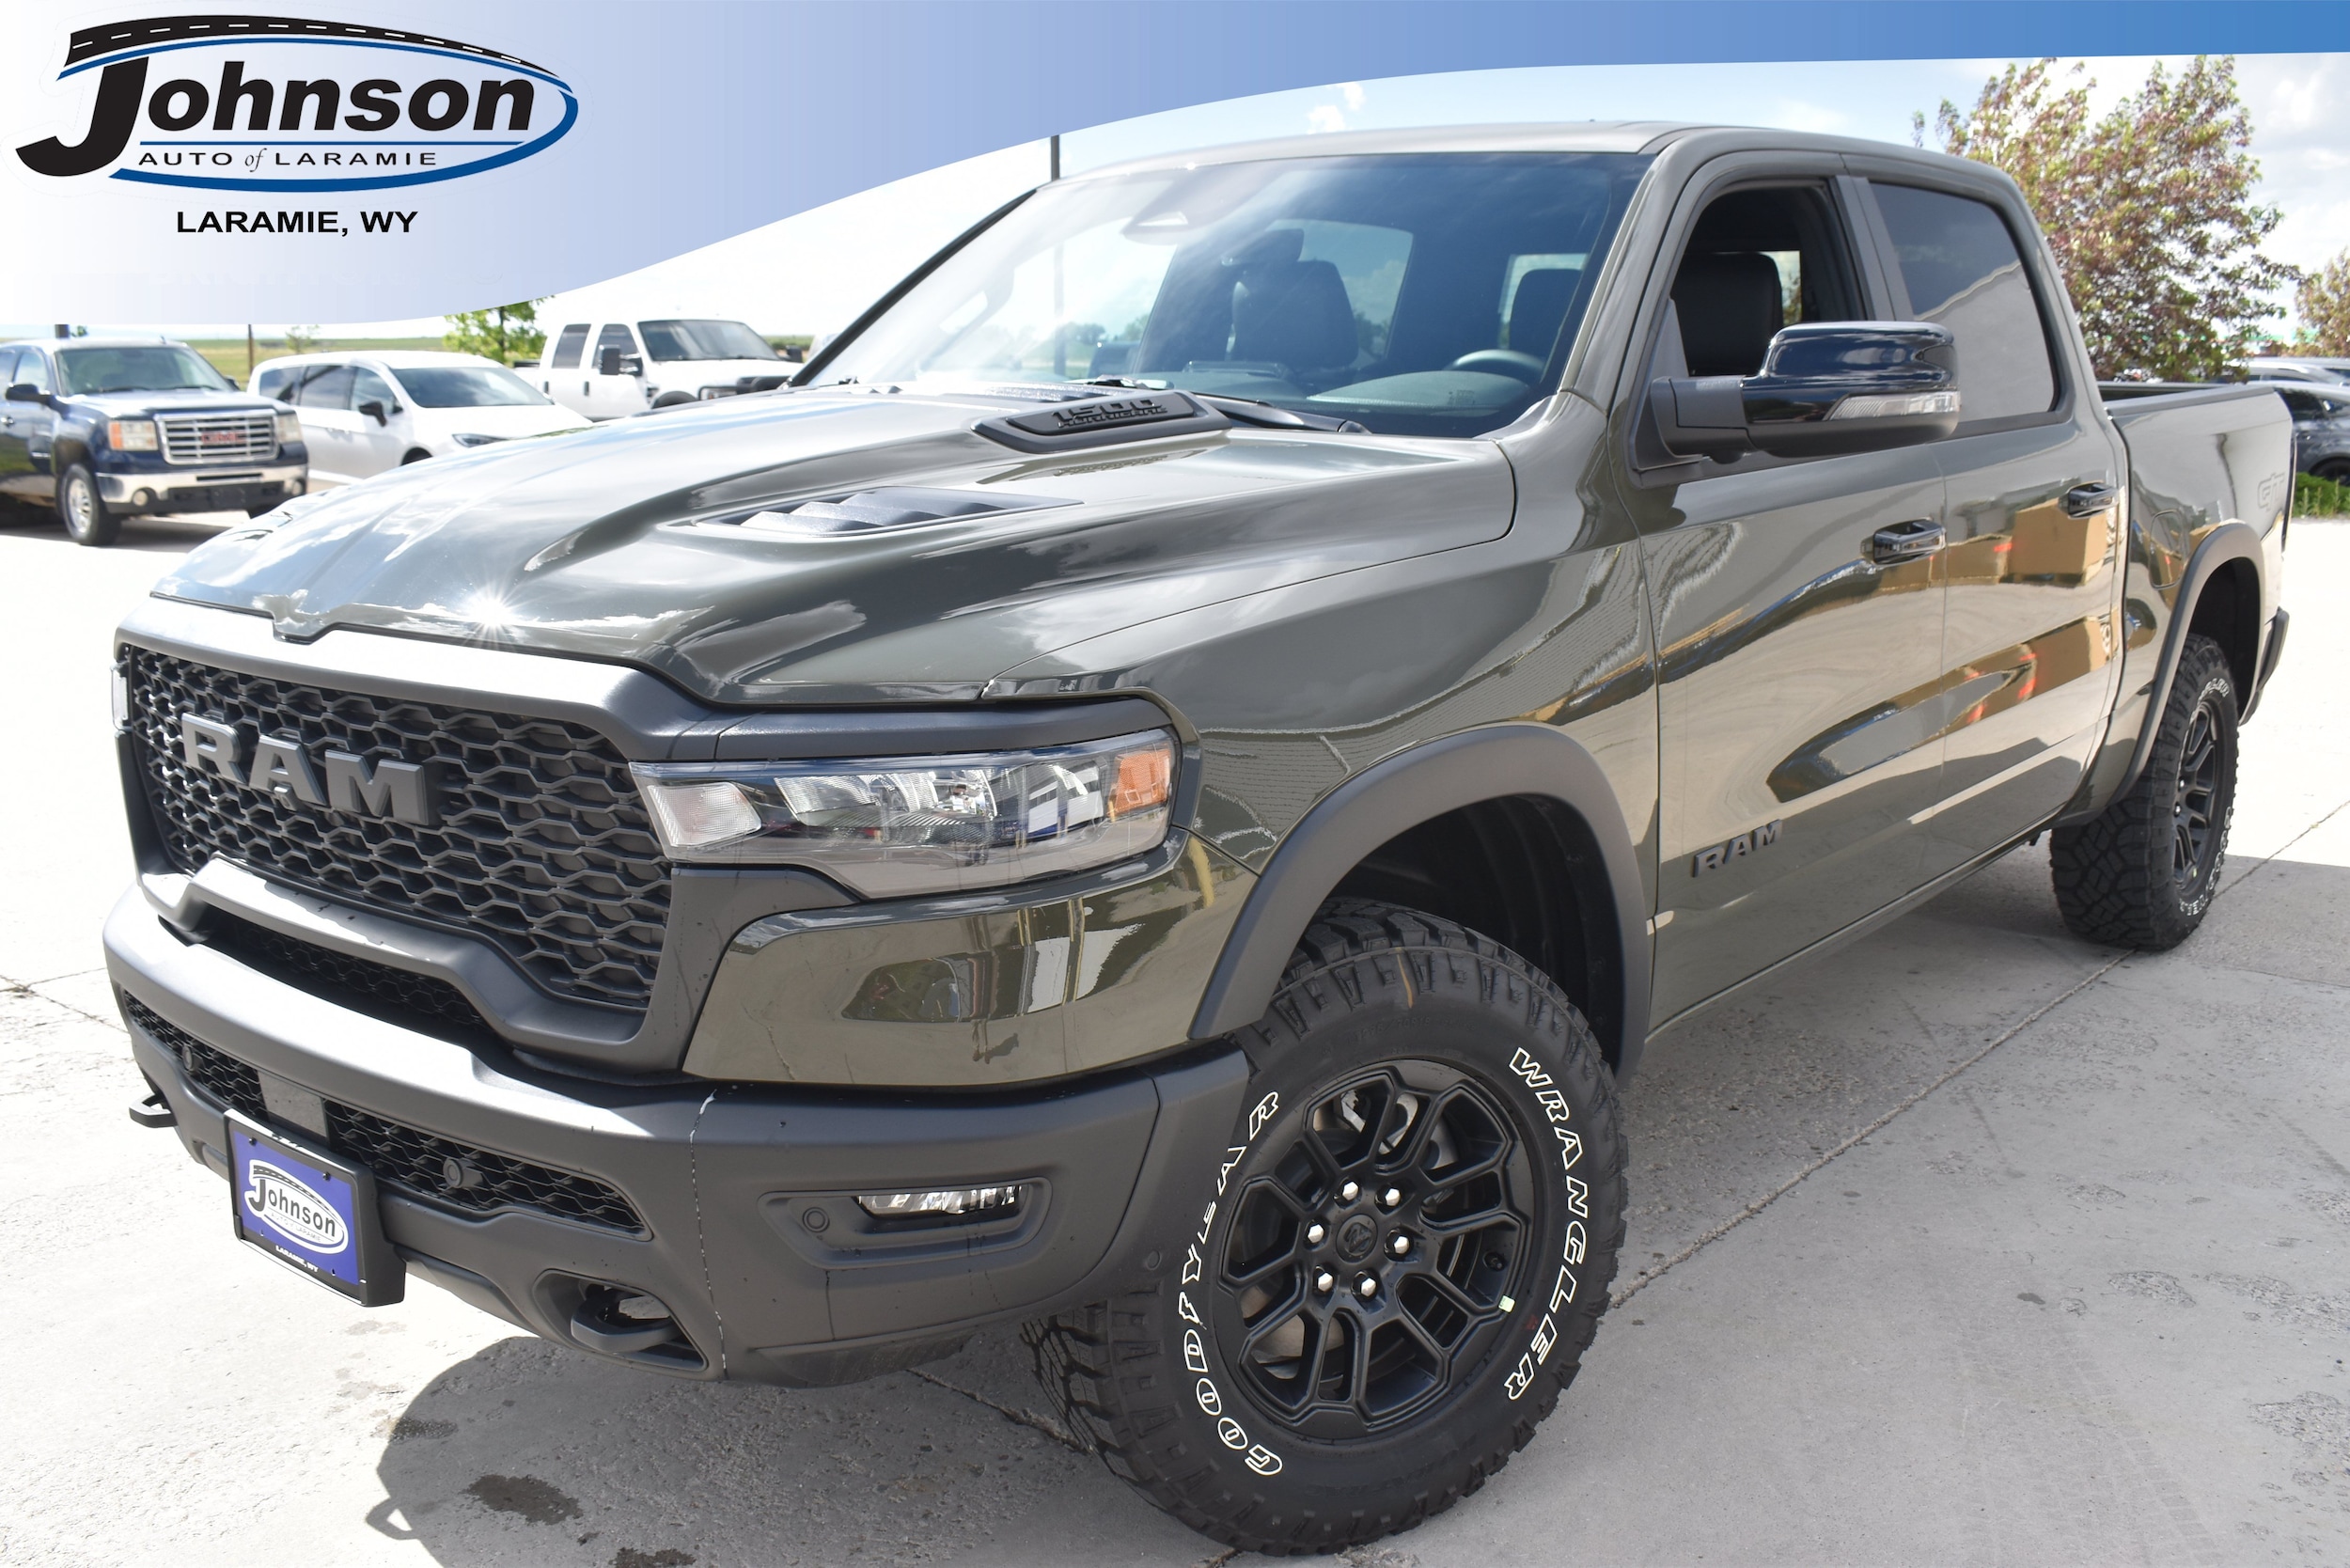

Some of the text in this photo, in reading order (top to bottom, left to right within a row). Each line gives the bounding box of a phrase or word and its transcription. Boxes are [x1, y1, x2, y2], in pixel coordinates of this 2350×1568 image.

[1051, 398, 1163, 422] 1500
[181, 712, 430, 826] RAM
[1690, 818, 1783, 878] RAM
[247, 1179, 336, 1237] Johnson
[1504, 1046, 1588, 1401] WRANGLER
[1178, 1091, 1283, 1476] GOODYEAR
